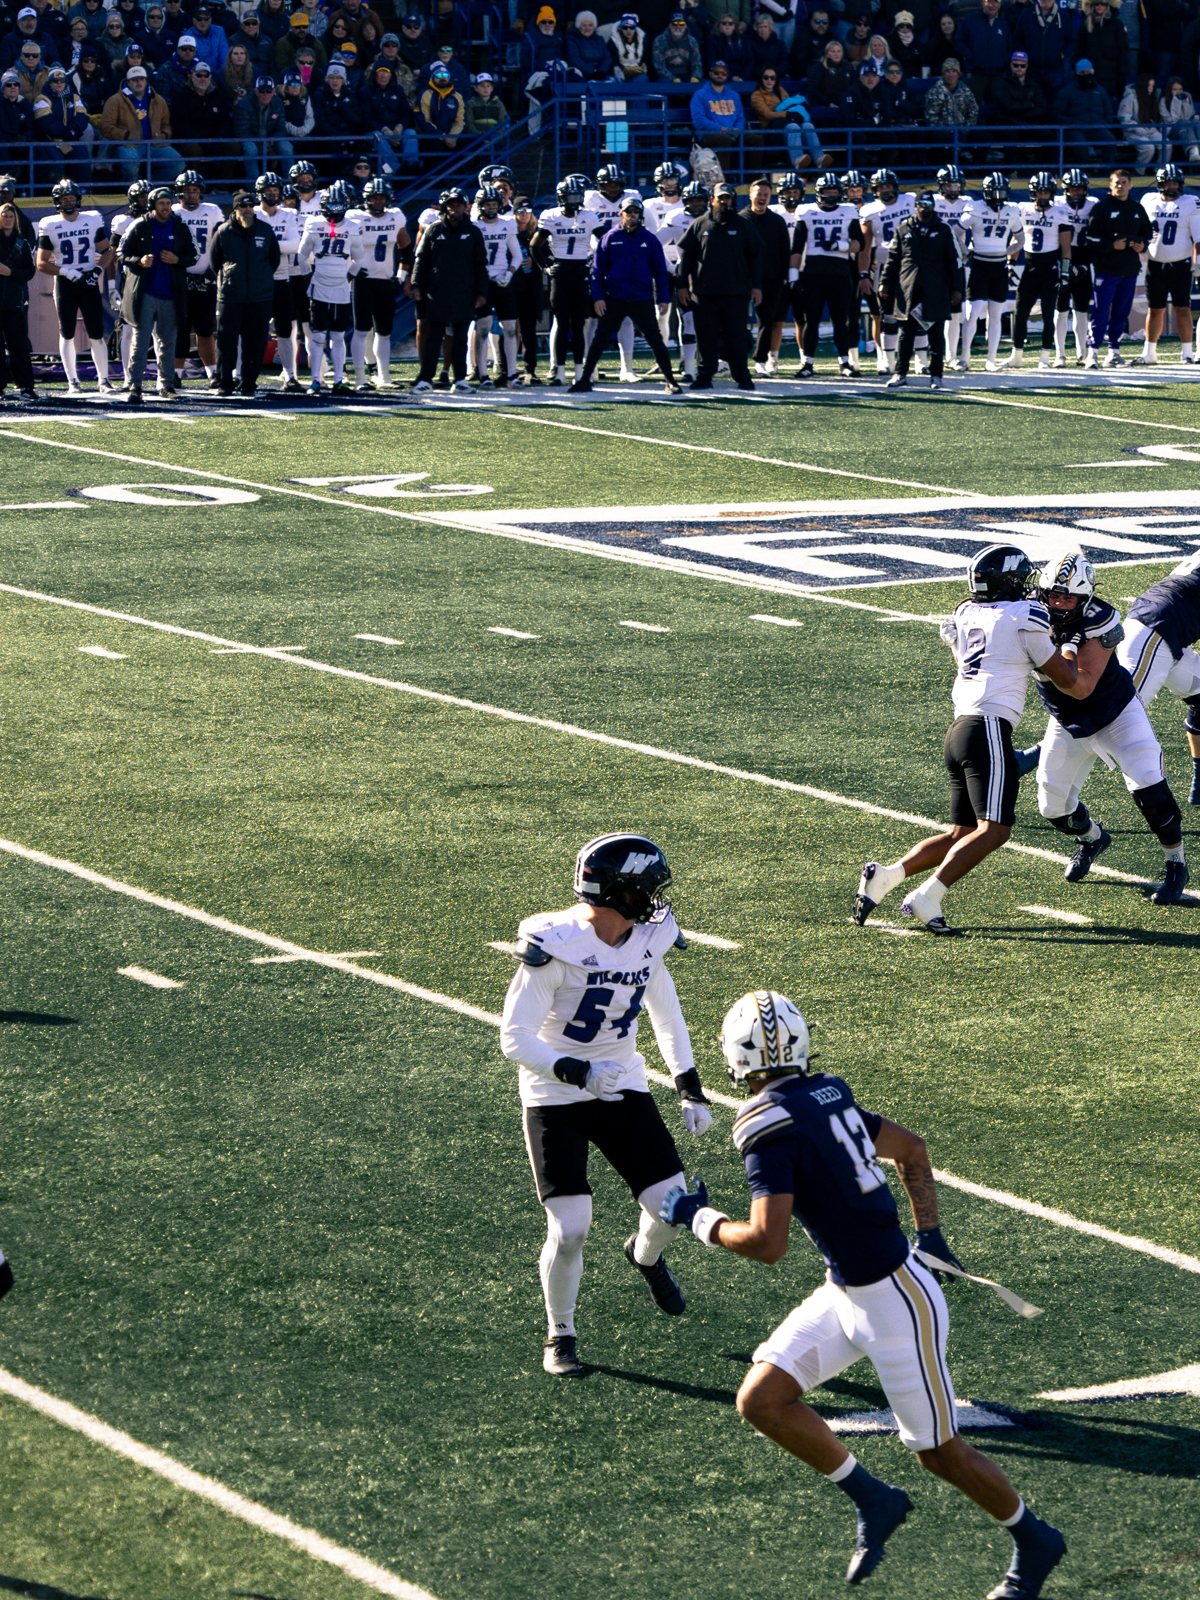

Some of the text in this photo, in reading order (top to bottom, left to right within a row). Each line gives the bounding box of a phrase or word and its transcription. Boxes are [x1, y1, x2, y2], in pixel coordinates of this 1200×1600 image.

[708, 99, 736, 113] MSU
[880, 209, 910, 222] WILDCATS
[1025, 219, 1053, 228] WILDCATS
[57, 228, 90, 240] WILDCATS
[365, 224, 396, 232] WILDCATS
[556, 227, 586, 235] WILDCATS
[320, 238, 345, 254] 10
[374, 234, 388, 262] 6
[566, 236, 577, 255] 1
[1031, 228, 1044, 252] 9
[60, 237, 90, 265] 92
[488, 243, 499, 265] 7
[809, 1085, 843, 1106] REED
[828, 1105, 887, 1195] 12
